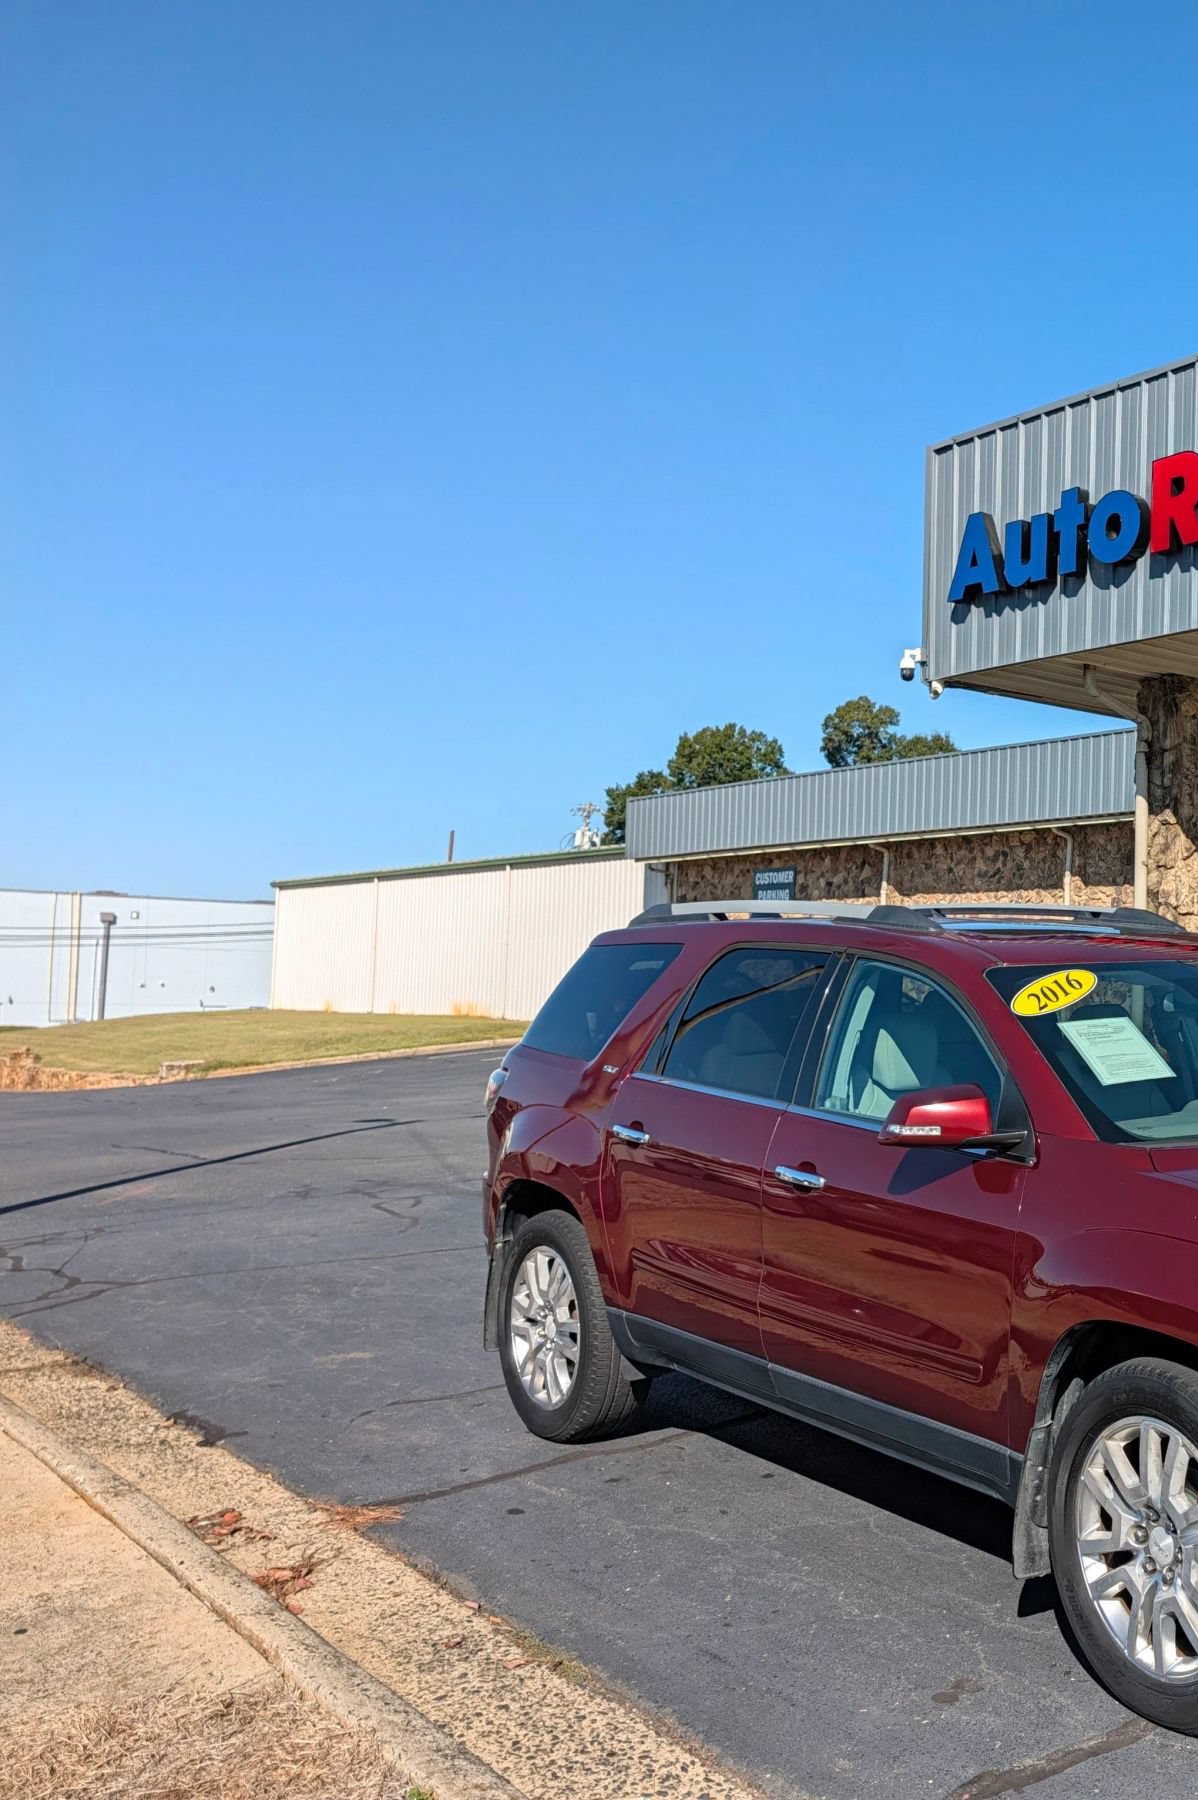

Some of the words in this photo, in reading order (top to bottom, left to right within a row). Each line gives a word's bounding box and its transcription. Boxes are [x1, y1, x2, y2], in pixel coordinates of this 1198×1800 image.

[755, 871, 793, 885] CUSTOMER
[758, 889, 789, 900] PARKING
[1027, 972, 1083, 1012] 2016
